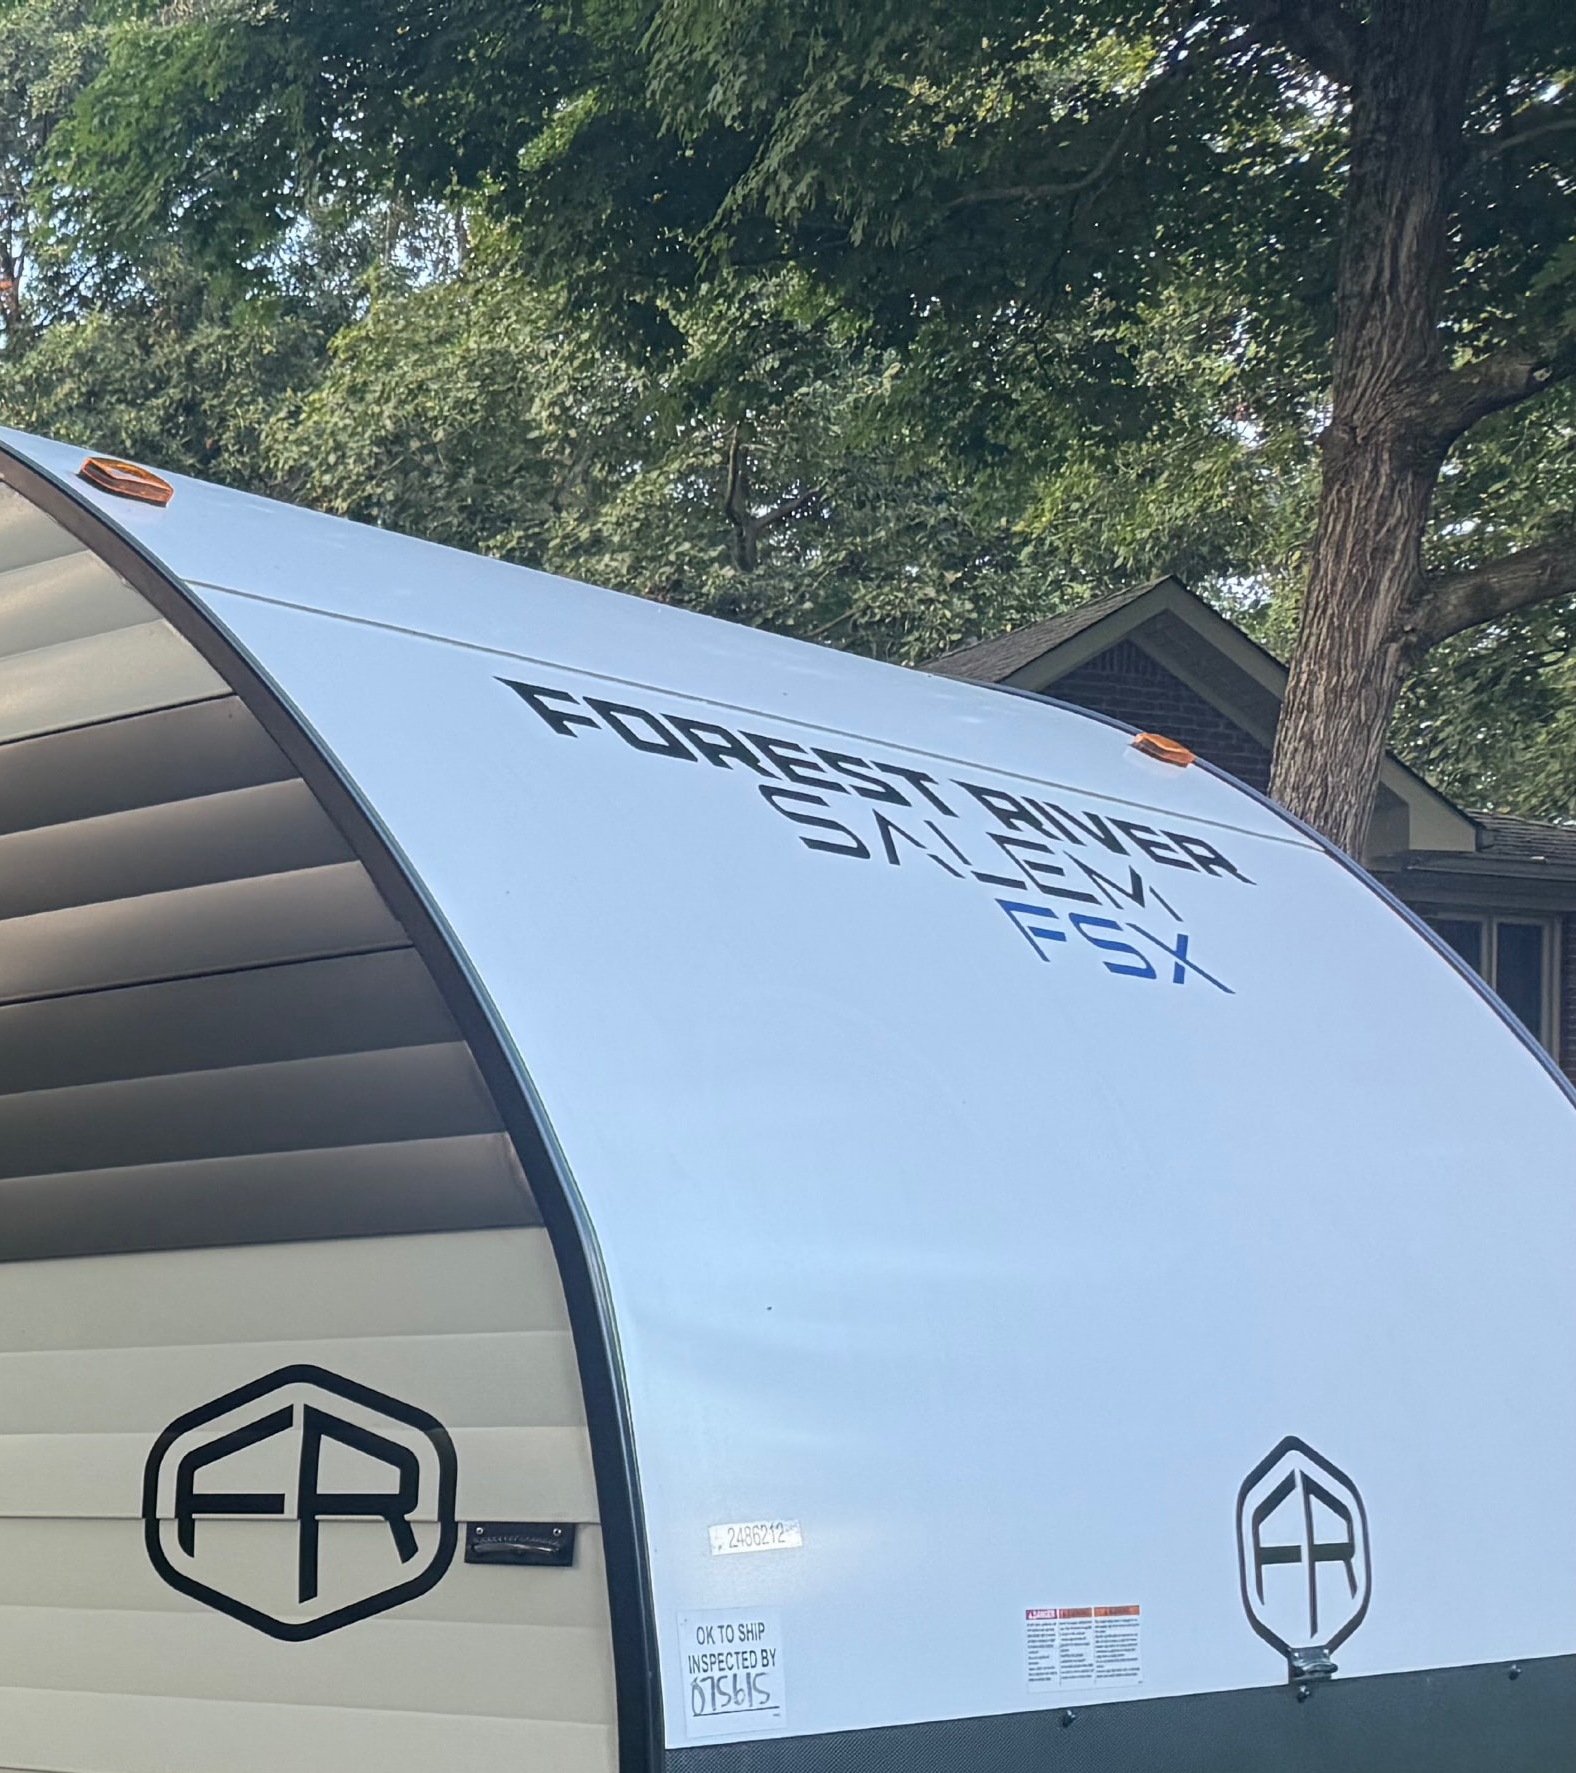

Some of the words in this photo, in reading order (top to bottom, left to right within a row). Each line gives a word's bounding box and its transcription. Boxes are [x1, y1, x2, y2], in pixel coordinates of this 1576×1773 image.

[493, 676, 958, 817] FOREST
[955, 779, 1256, 885] RIVER
[757, 782, 1182, 921] SALEM
[995, 897, 1235, 995] FSX
[688, 1650, 757, 1675] INSPECTED
[761, 1648, 776, 1668] BY
[696, 1625, 715, 1645] OK
[717, 1624, 735, 1644] TO
[738, 1622, 765, 1642] SHIP
